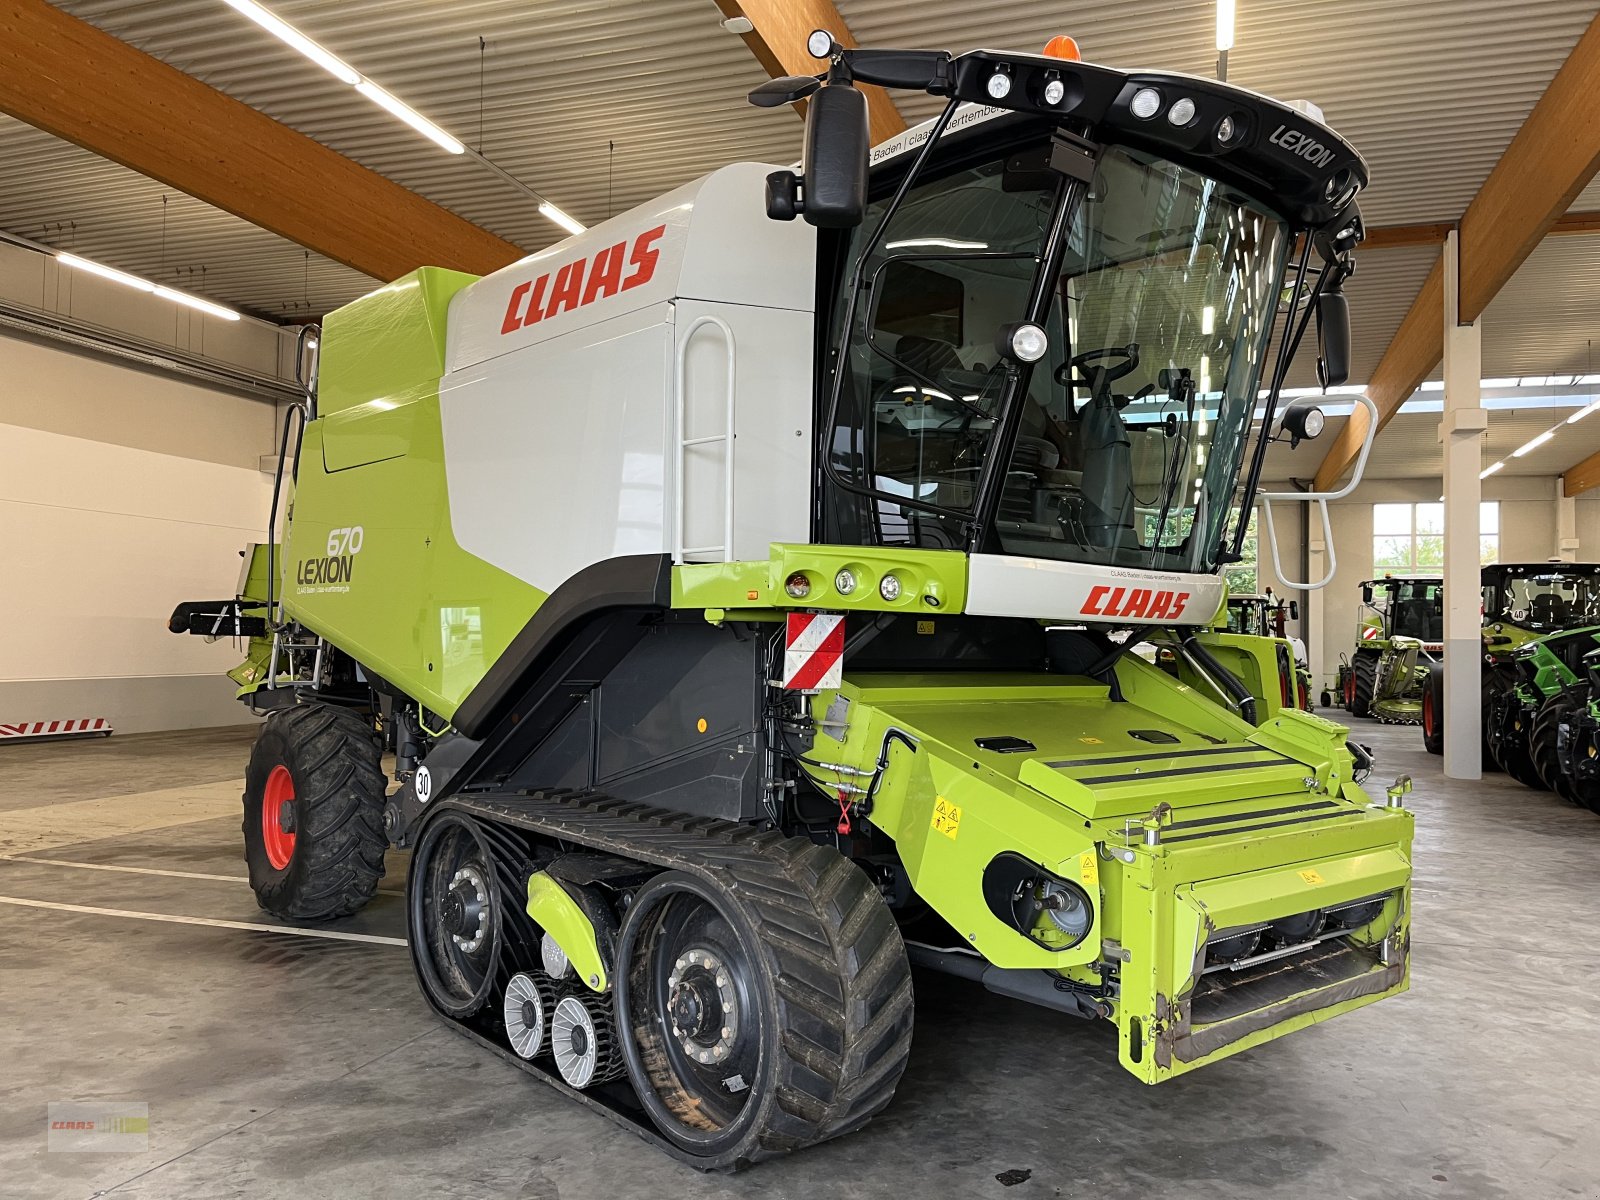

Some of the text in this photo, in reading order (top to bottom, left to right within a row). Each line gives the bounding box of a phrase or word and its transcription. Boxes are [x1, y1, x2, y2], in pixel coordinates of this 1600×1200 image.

[873, 141, 902, 162] Baden
[1269, 124, 1336, 169] LEXION
[500, 223, 667, 335] CLAAS
[328, 526, 363, 556] 670
[297, 555, 354, 585] LEXION
[1079, 585, 1191, 620] CLAAS
[1514, 610, 1524, 619] 40
[417, 773, 428, 795] 30
